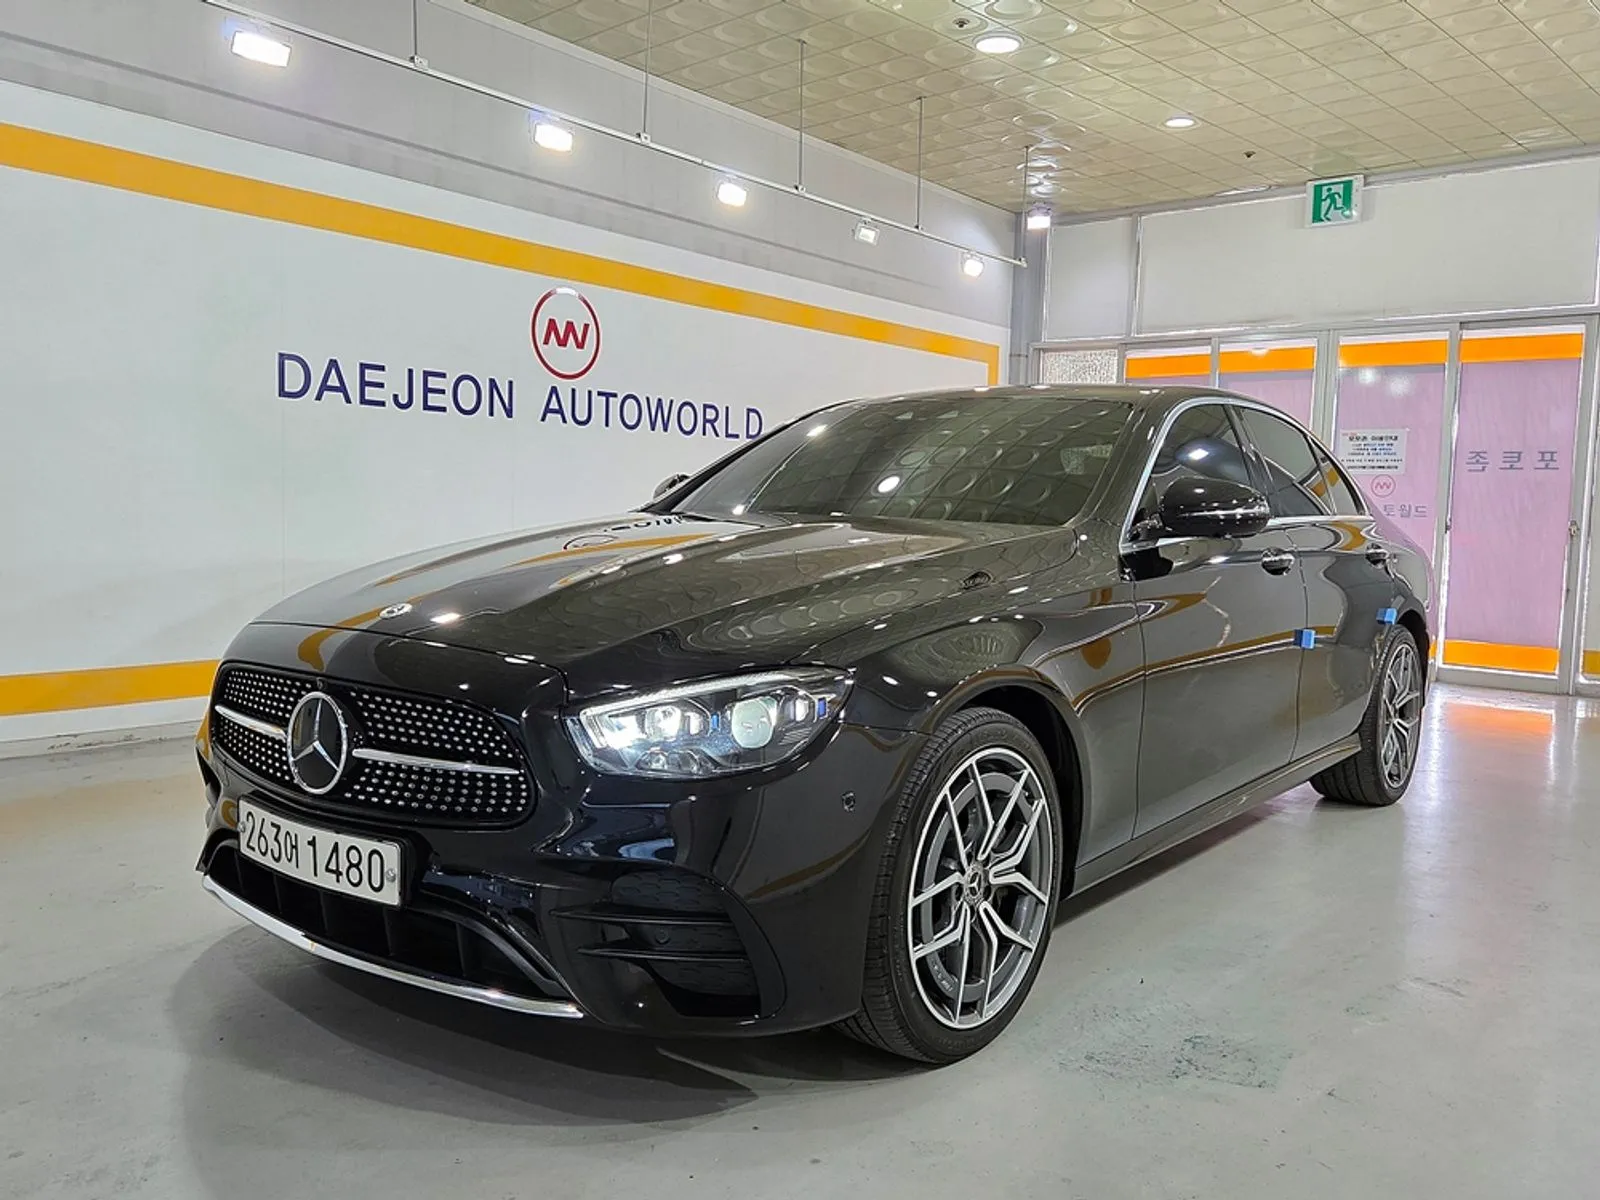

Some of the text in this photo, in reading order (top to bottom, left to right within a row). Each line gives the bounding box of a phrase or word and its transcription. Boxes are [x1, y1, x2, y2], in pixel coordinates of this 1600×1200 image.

[277, 352, 764, 440] DAEJEON AUTOWORLD
[246, 811, 385, 893] 263어 1480
